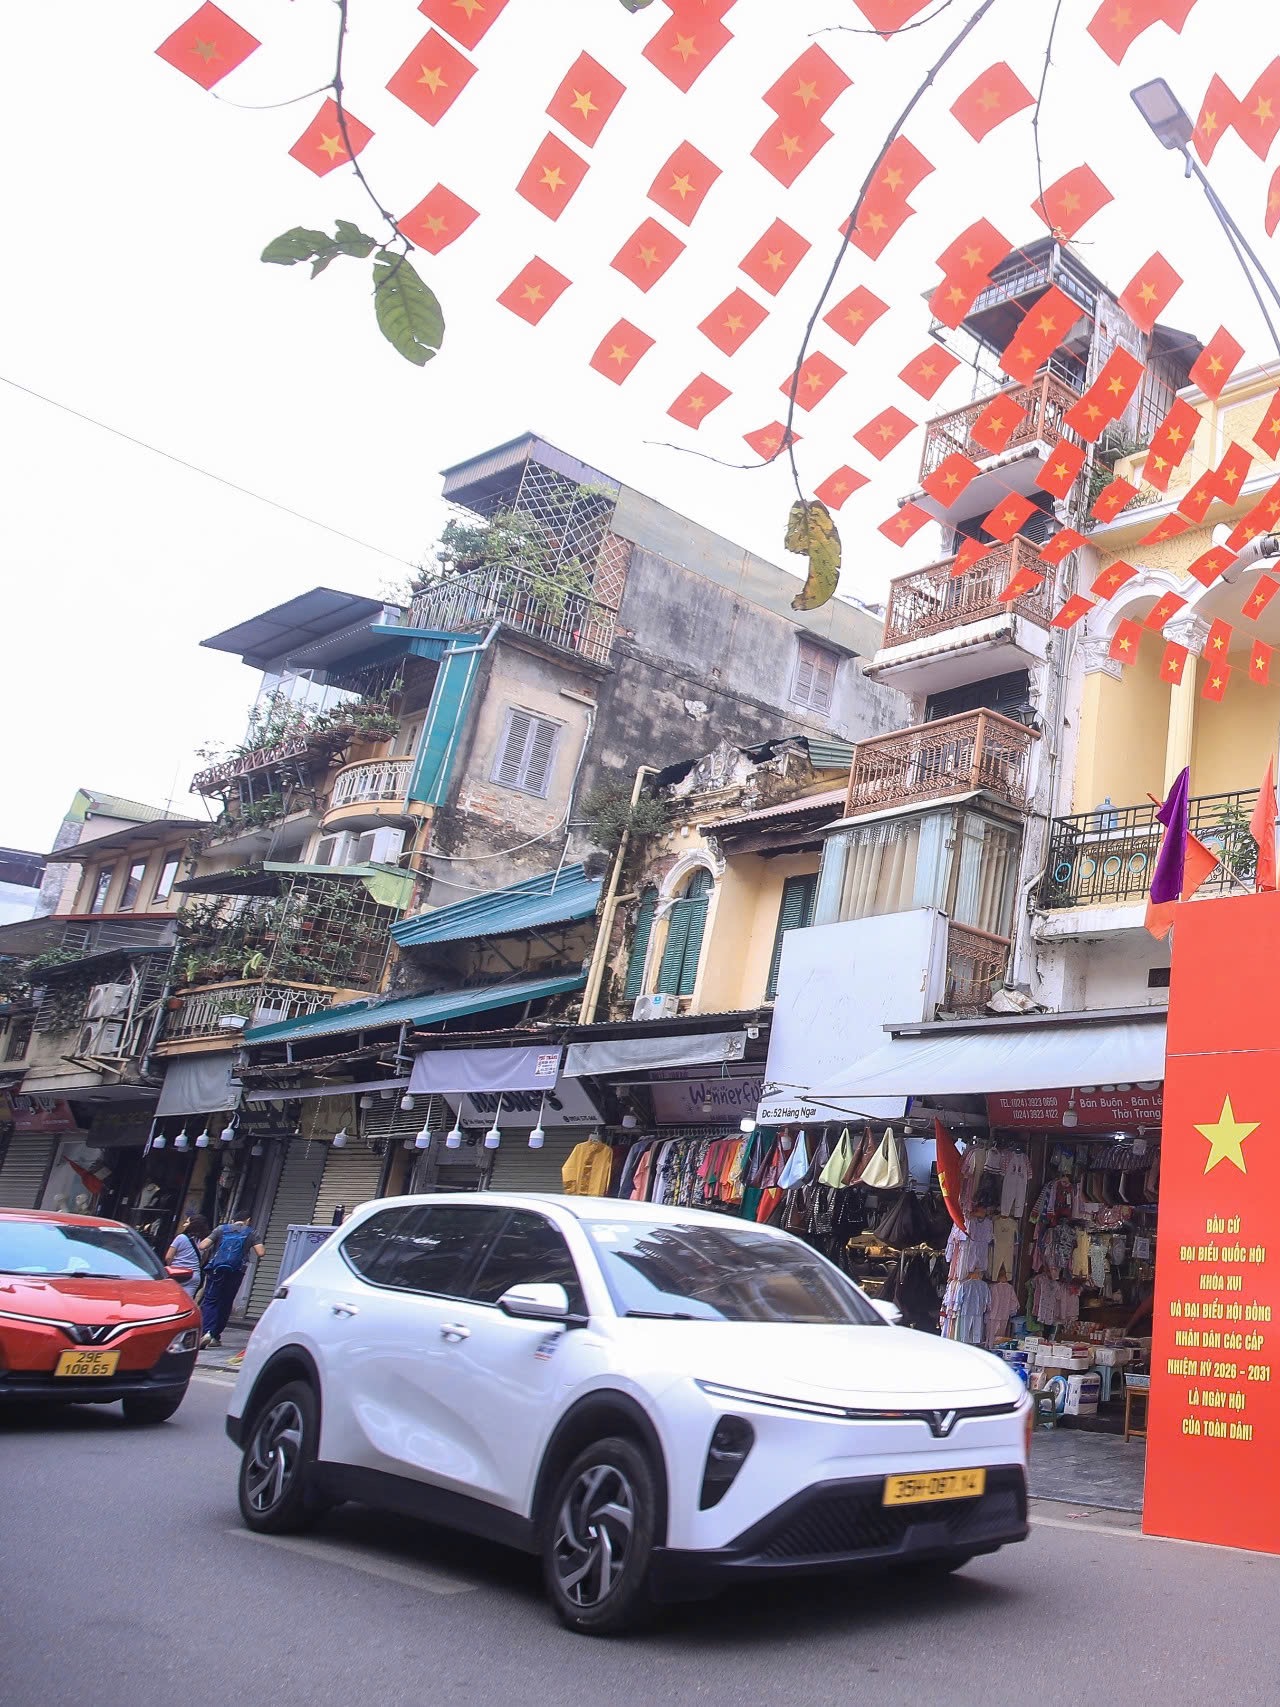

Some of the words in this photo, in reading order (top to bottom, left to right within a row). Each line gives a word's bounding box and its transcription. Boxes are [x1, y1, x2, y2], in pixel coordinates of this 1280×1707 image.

[1080, 1099, 1097, 1108] Bán
[1100, 1098, 1123, 1108] Buôn
[1132, 1096, 1149, 1106] Bán
[1152, 1094, 1163, 1105] Lẻ
[1112, 1108, 1133, 1119] Thời
[1135, 1108, 1161, 1120] Trang
[1206, 1213, 1225, 1234] BẦU
[1227, 1214, 1241, 1234] CỬ
[1179, 1245, 1196, 1264] ĐẠI
[1197, 1240, 1219, 1262] BIỂU
[1221, 1241, 1247, 1263] QUỐC
[1248, 1244, 1266, 1266] HỘI
[1199, 1272, 1225, 1291] KHÓA
[1226, 1275, 1242, 1292] XVI
[1170, 1299, 1182, 1318] VÀ
[1184, 1302, 1200, 1321] ĐẠI
[1202, 1297, 1224, 1320] BIỂU
[1225, 1301, 1243, 1323] HỘI
[1244, 1299, 1272, 1322] ĐỒNG
[1175, 1328, 1200, 1347] NHÂN
[1202, 1329, 1221, 1349] DÂN
[1223, 1330, 1243, 1350] CÁC
[1244, 1329, 1264, 1351] CẤP
[76, 1352, 105, 1363] 29E
[65, 1363, 110, 1375] 108.65
[1167, 1356, 1198, 1378] NHIỆM
[1199, 1358, 1213, 1377] KỲ
[1213, 1362, 1237, 1379] 2026
[1247, 1364, 1270, 1382] 2031
[1188, 1386, 1200, 1406] LÀ
[1201, 1388, 1227, 1408] NGÀY
[1228, 1390, 1245, 1413] HỘI
[1182, 1414, 1201, 1436] CỦA
[1203, 1418, 1227, 1438] TOÀN
[1229, 1420, 1253, 1441] DÂN!
